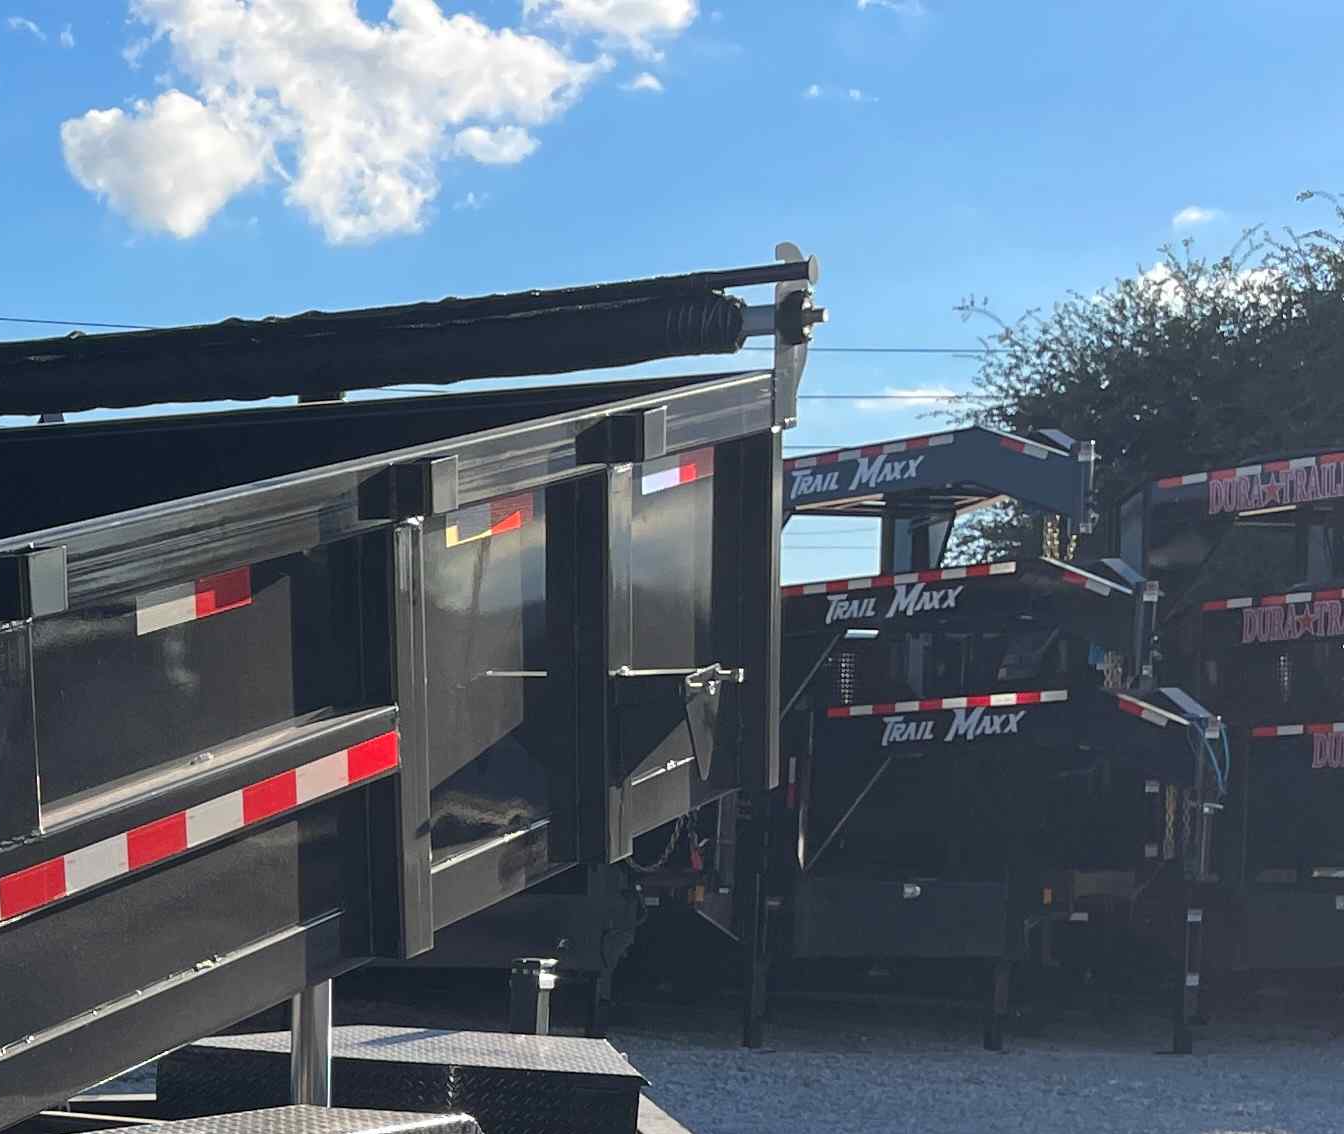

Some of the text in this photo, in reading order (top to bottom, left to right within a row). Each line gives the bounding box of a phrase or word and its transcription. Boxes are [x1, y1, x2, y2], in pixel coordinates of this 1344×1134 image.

[789, 454, 925, 499] TRAIL MAXX
[1208, 471, 1265, 515] DURA
[825, 582, 965, 625] TRAIL MAXX
[1241, 603, 1301, 644] DURA
[881, 706, 1027, 747] TRAIL MAXX
